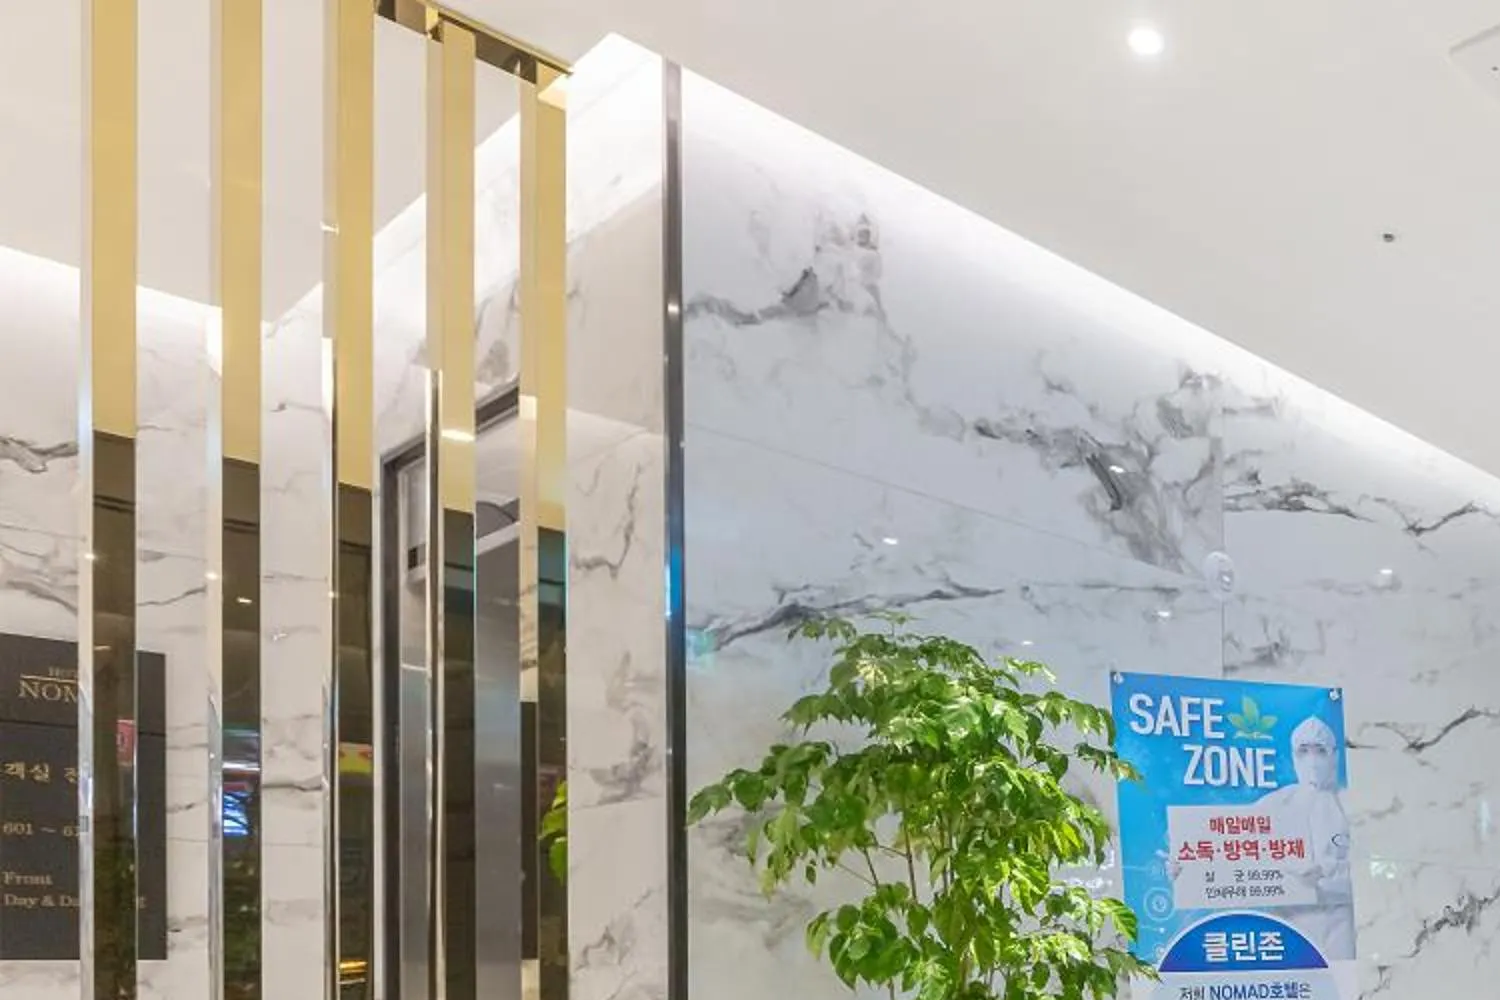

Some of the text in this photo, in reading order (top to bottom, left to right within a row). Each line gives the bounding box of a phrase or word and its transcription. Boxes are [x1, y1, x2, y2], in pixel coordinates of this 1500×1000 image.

[18, 680, 79, 703] NOM
[1129, 693, 1225, 739] SAFE
[1183, 744, 1277, 788] ZONE
[1209, 815, 1271, 834] 매일매일
[4, 894, 36, 908] Day
[1202, 931, 1285, 962] 클린존
